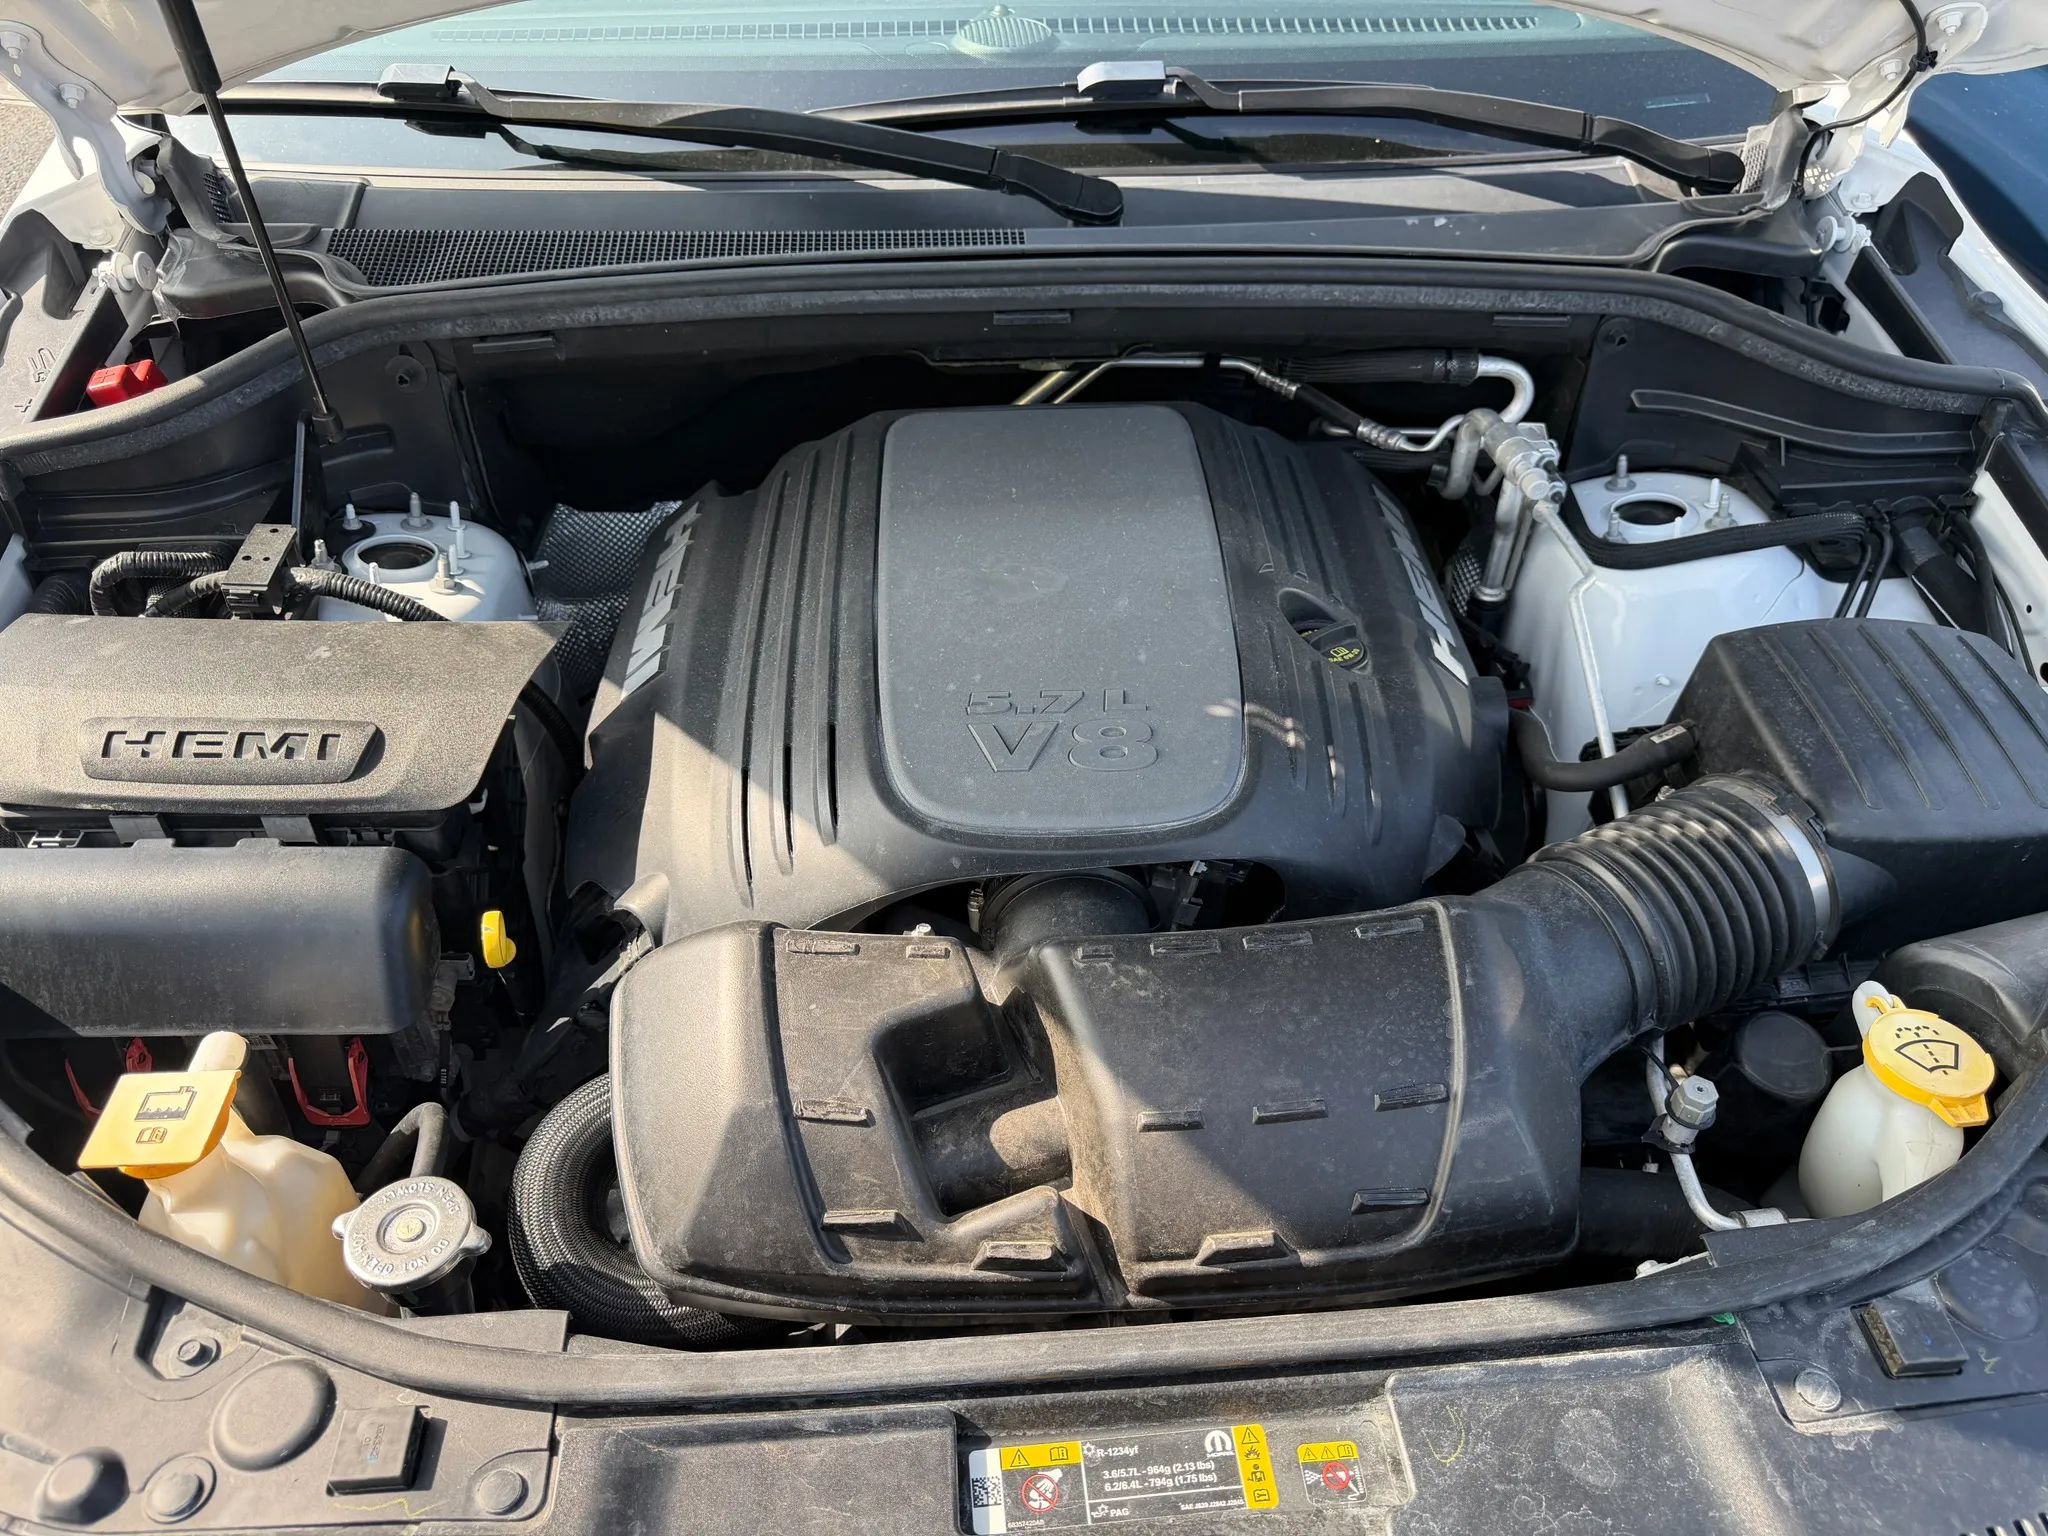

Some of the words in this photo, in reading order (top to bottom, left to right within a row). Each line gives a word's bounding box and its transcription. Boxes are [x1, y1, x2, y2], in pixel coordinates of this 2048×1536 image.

[622, 502, 701, 697] HEMI
[965, 689, 1149, 715] 5.7L
[101, 730, 341, 761] HEMI
[967, 718, 1159, 772] V8
[381, 1183, 435, 1205] SLOWLY
[438, 1186, 461, 1214] OPEN
[431, 1239, 450, 1256] DO
[404, 1255, 429, 1271] NOT
[1096, 1445, 1139, 1458] R-1234yf
[1103, 1467, 1141, 1479] 3.6/5.7L
[1147, 1465, 1171, 1475] 964g
[1172, 1462, 1196, 1474] (2.13
[1196, 1460, 1215, 1471] lbs)
[1104, 1480, 1143, 1491] 6.2/6.4L
[1148, 1477, 1174, 1487] 794g
[1174, 1474, 1198, 1486] (1.75
[1198, 1472, 1217, 1483] lbs)
[1110, 1508, 1129, 1517] PAG
